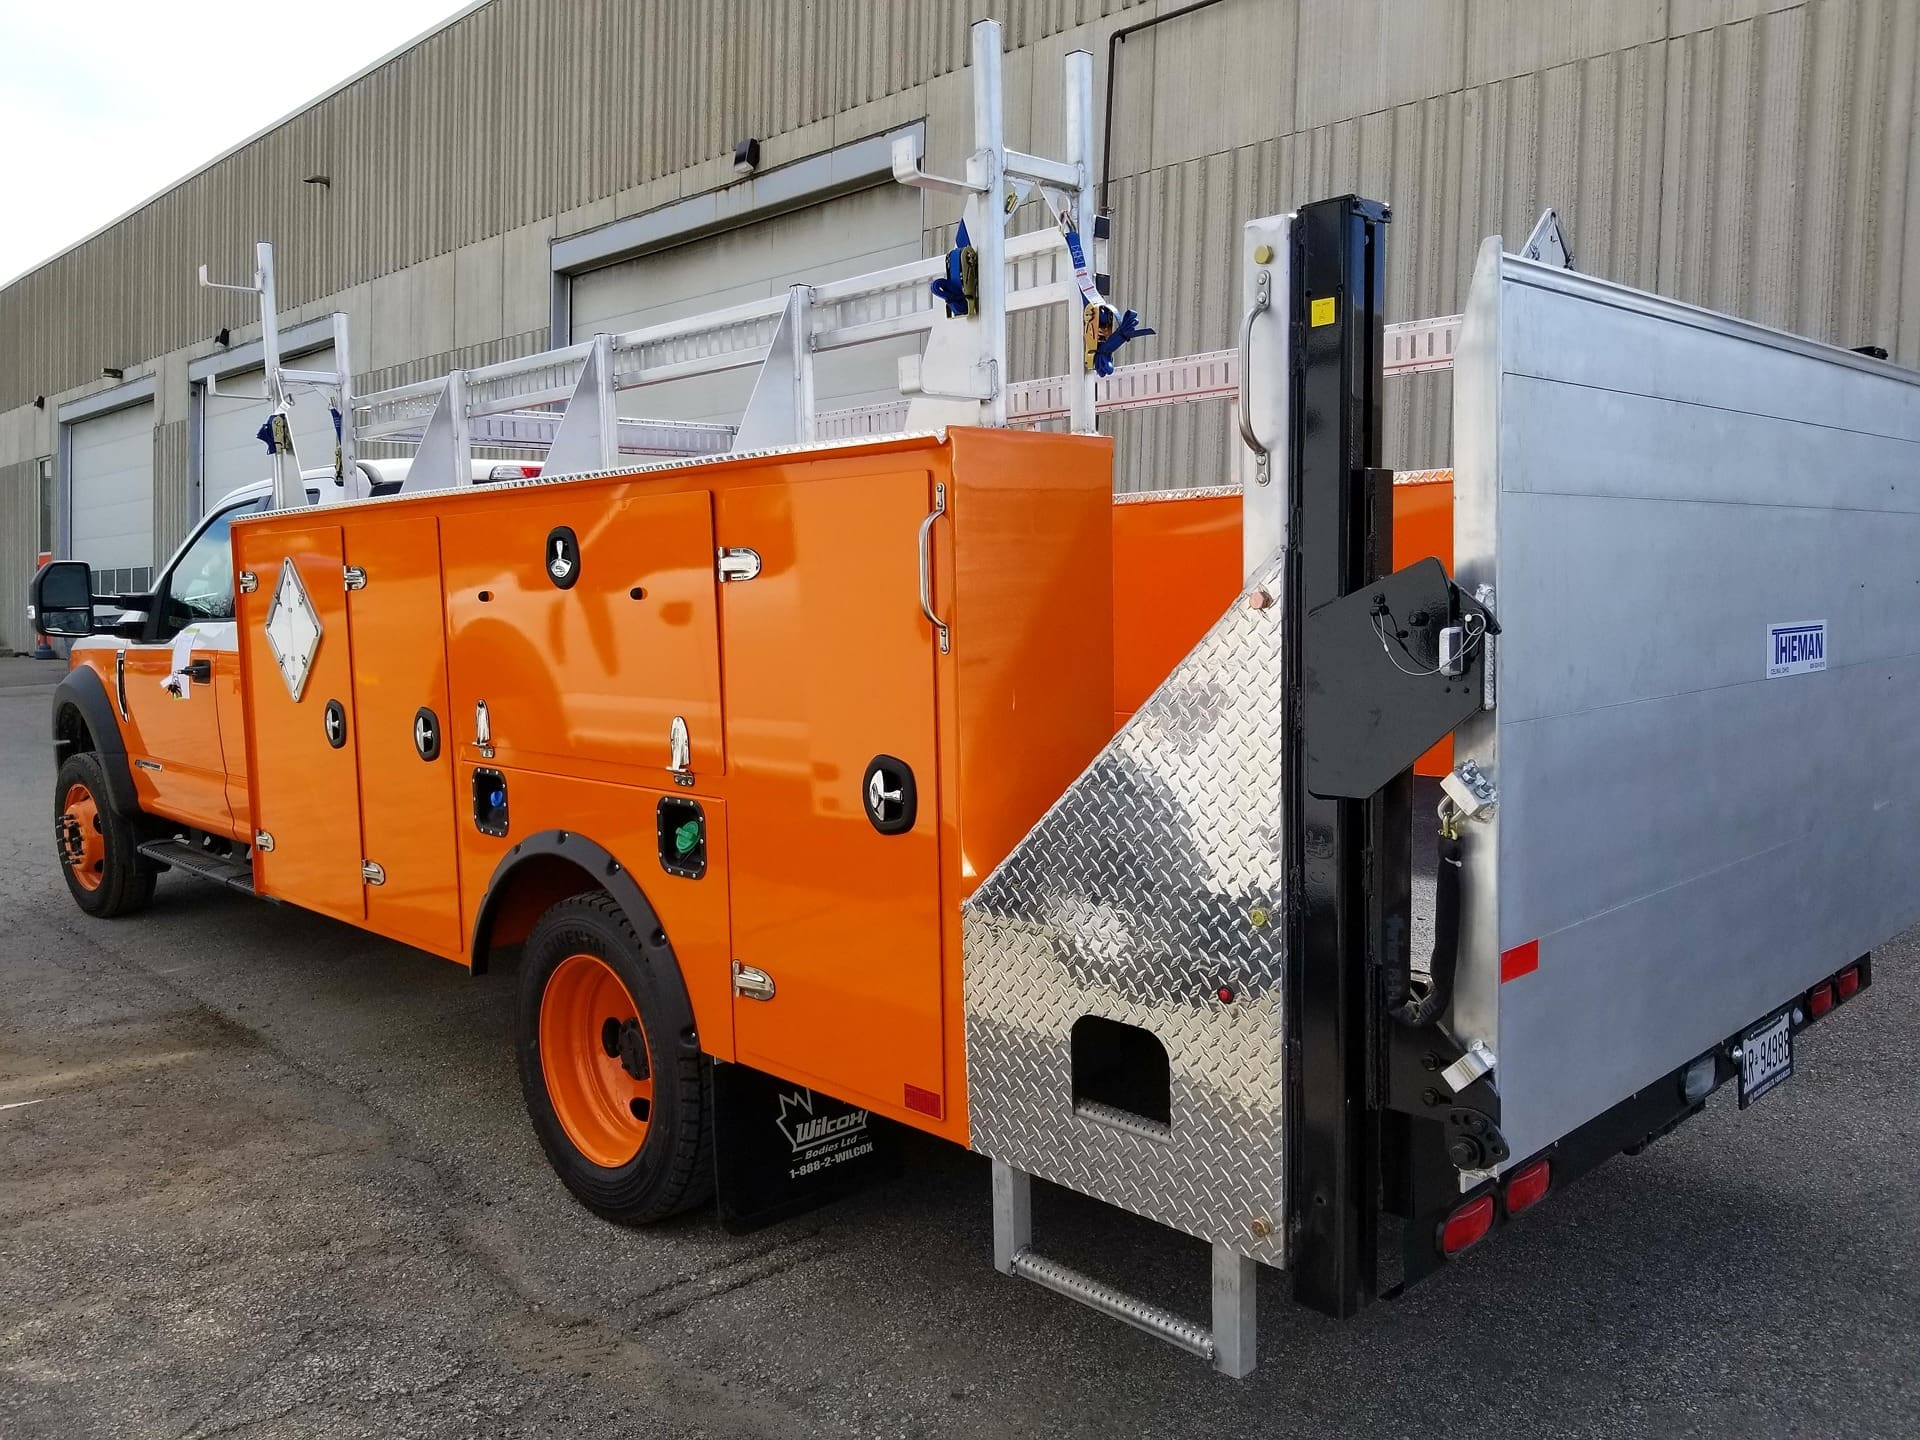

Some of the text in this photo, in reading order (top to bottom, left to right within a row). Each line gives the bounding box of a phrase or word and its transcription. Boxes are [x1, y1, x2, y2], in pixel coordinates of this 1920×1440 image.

[1771, 624, 1824, 665] THIEMAN
[795, 1109, 864, 1144] Wilcox
[789, 1141, 874, 1179] 1-888-2-WILCOX
[805, 1134, 859, 1160] Bodies Ltd
